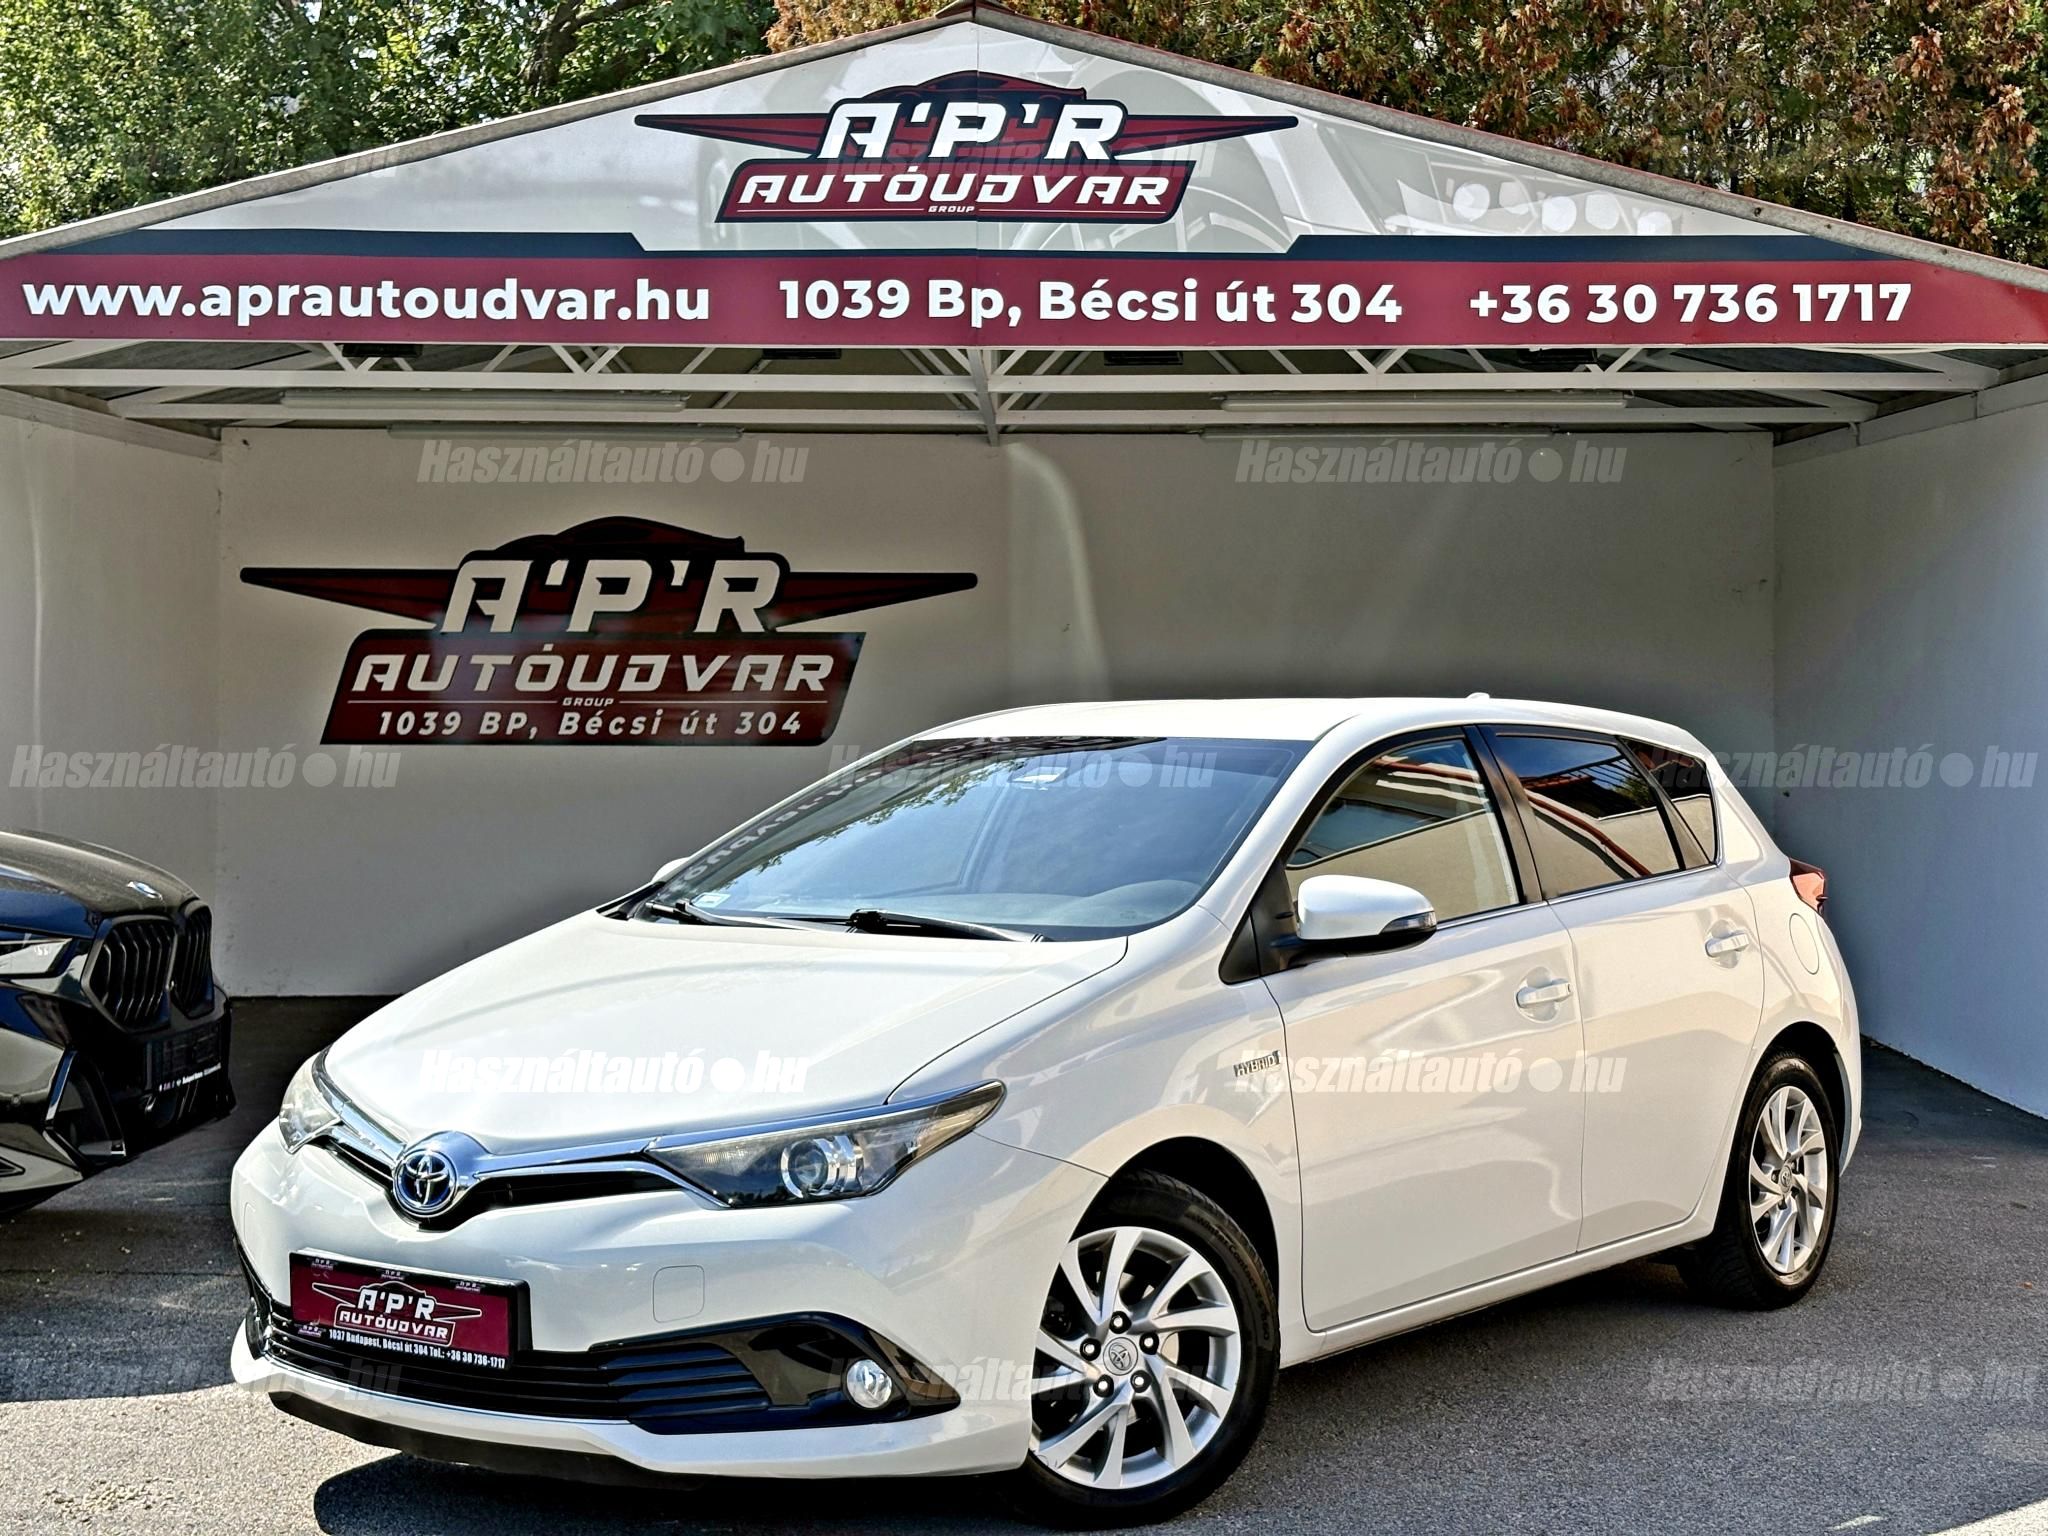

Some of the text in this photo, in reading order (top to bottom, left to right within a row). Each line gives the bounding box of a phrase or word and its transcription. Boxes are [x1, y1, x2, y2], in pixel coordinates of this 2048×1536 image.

[737, 165, 1170, 206] AUTÓUDVAR
[928, 205, 975, 213] GROUP
[22, 278, 710, 327] www.aprautoudvar.hu
[779, 277, 1403, 329] 1039 Bp, Bécsi út 304
[1470, 283, 1912, 324] +36 30 736 1717
[351, 643, 835, 693] AUTÓUDVAR
[562, 697, 614, 707] GROUP
[379, 708, 801, 739] 1039 BP, Bécsi út 304
[1233, 1050, 1281, 1077] HYBRID
[339, 1309, 449, 1340] AUTÓUDVAR
[346, 1331, 382, 1349] Budapest,
[382, 1338, 404, 1352] Bécsi
[404, 1341, 414, 1353] út
